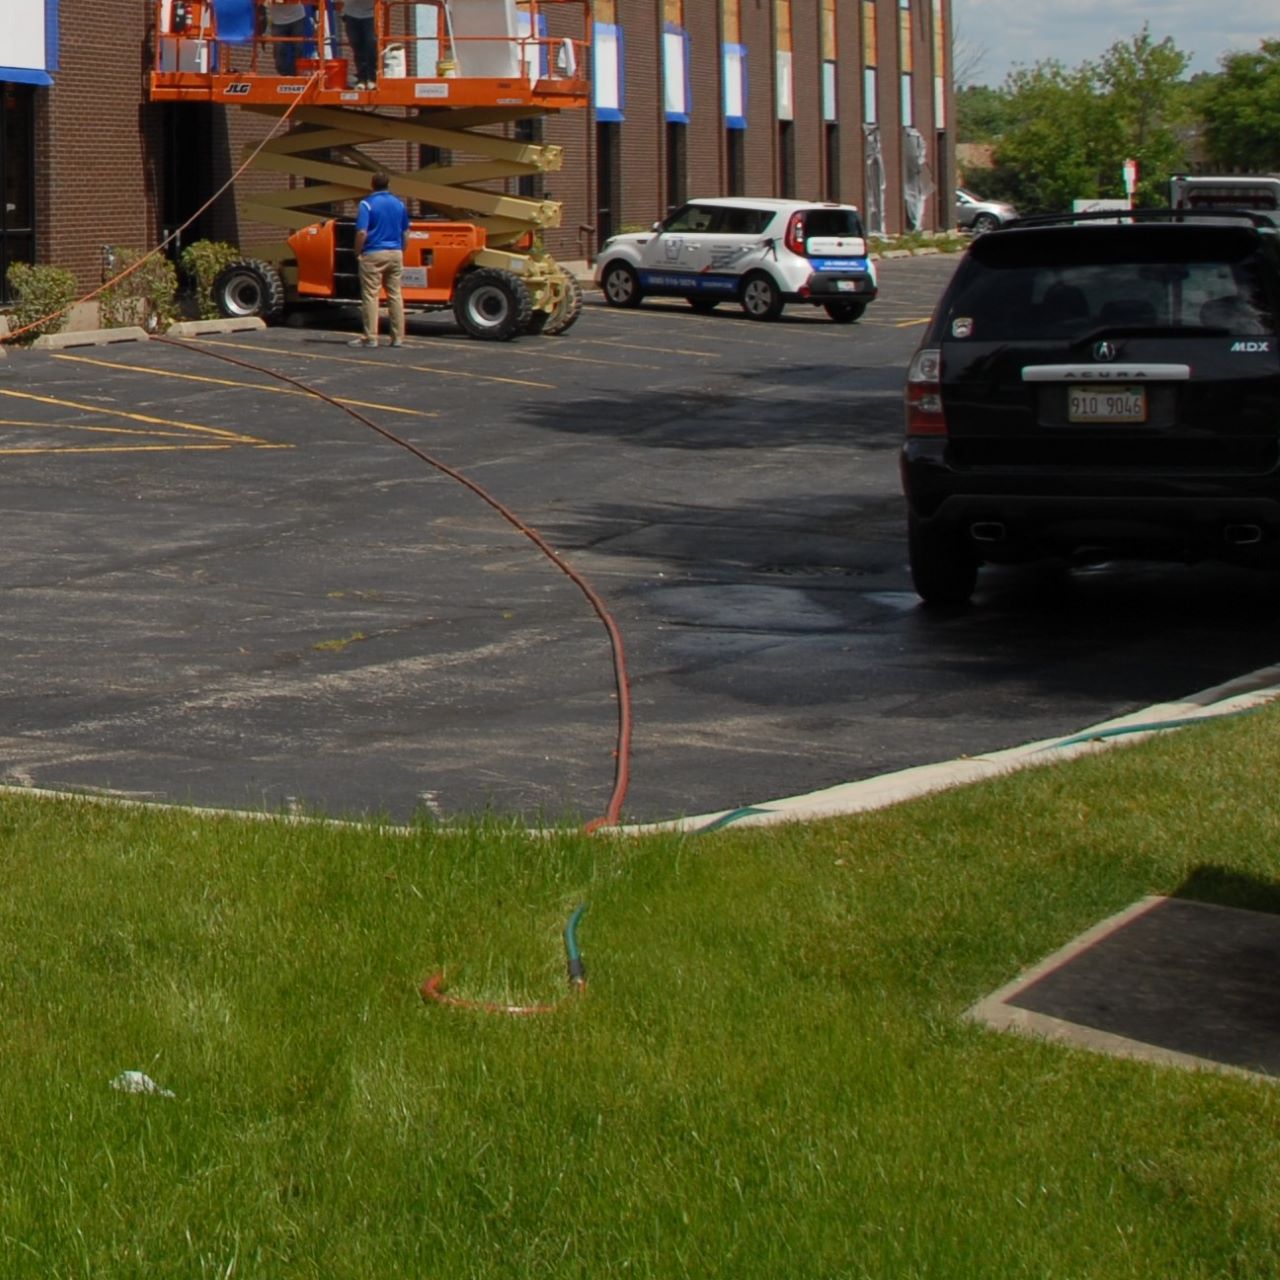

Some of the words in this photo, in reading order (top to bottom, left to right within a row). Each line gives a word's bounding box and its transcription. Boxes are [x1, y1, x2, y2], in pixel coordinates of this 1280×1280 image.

[225, 84, 250, 94] JLG
[1230, 341, 1269, 352] MDX
[1071, 396, 1098, 414] 910
[1106, 396, 1142, 415] 9046
